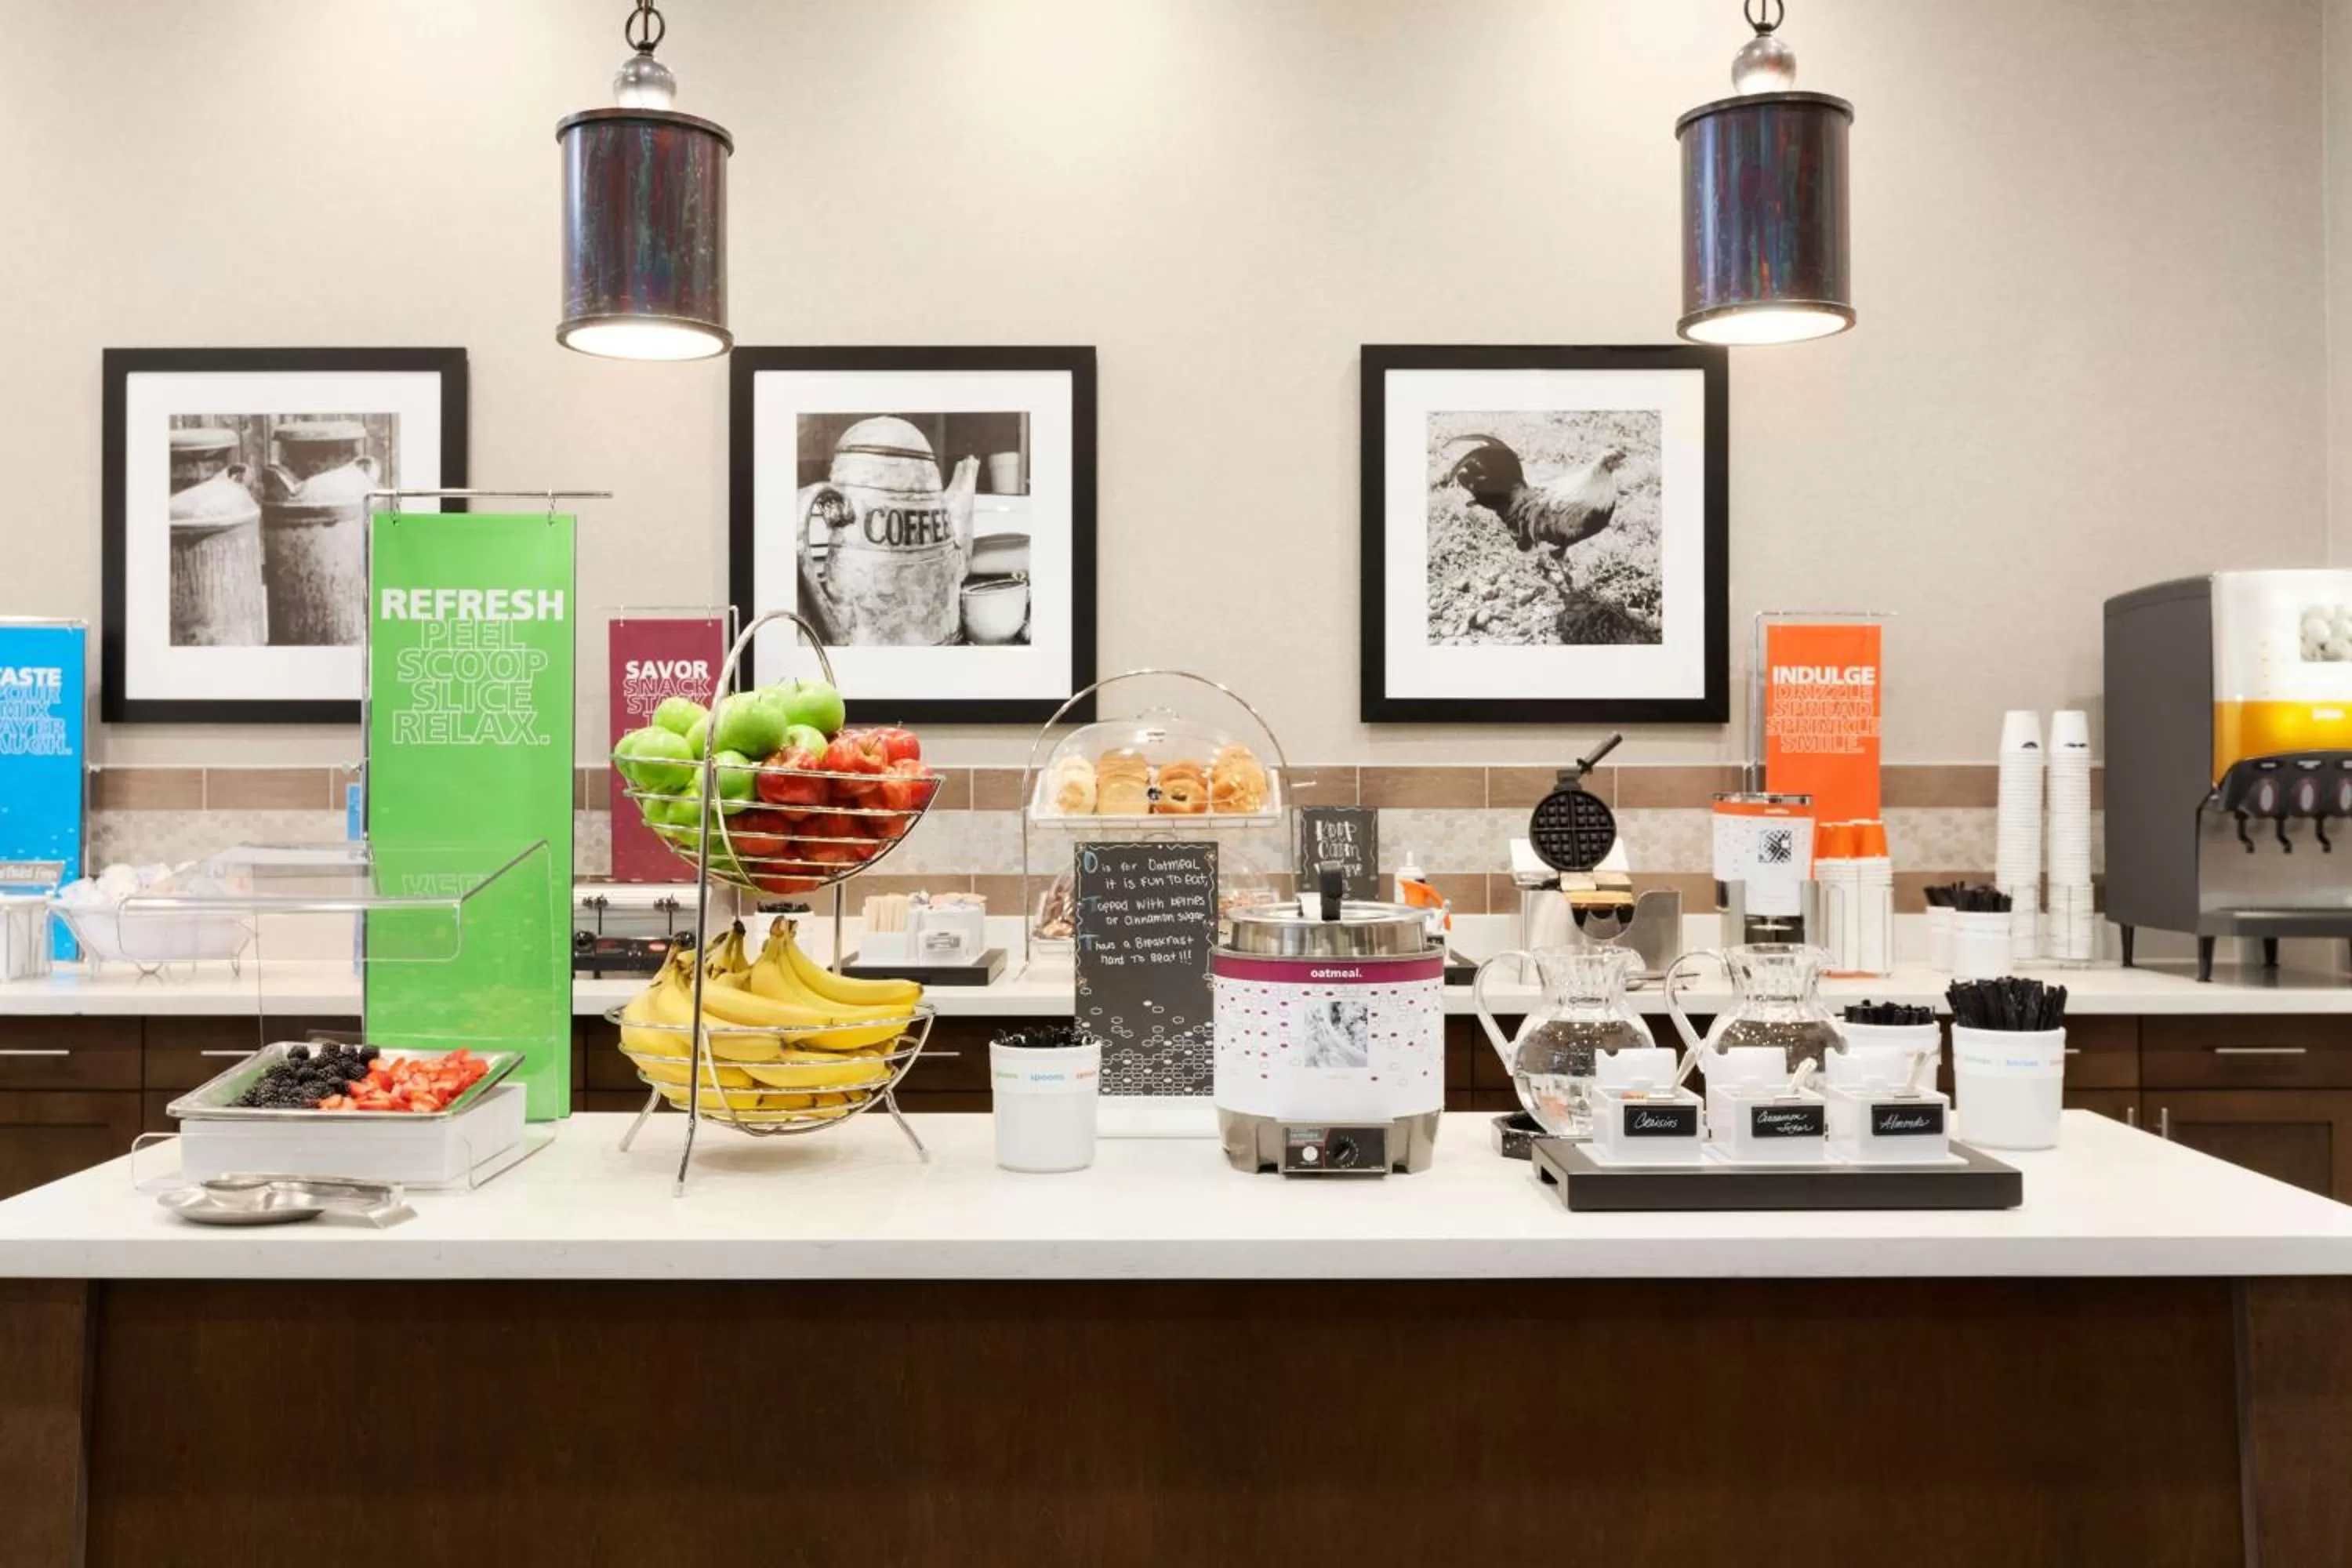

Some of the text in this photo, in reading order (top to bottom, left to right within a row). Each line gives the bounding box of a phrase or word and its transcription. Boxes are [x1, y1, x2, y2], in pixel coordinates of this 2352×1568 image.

[380, 588, 564, 621] REFRESH
[421, 617, 526, 651] PEEL
[397, 648, 548, 683] SCOOP
[625, 659, 709, 680] SAVOR
[1773, 666, 1876, 685] INDULGE
[0, 668, 63, 688] ASTE
[622, 677, 712, 697] SNACK
[0, 686, 63, 704] OUR
[411, 681, 533, 714] SLICE
[392, 711, 550, 745] RELAX.
[1310, 967, 1363, 978] oatmeal.
